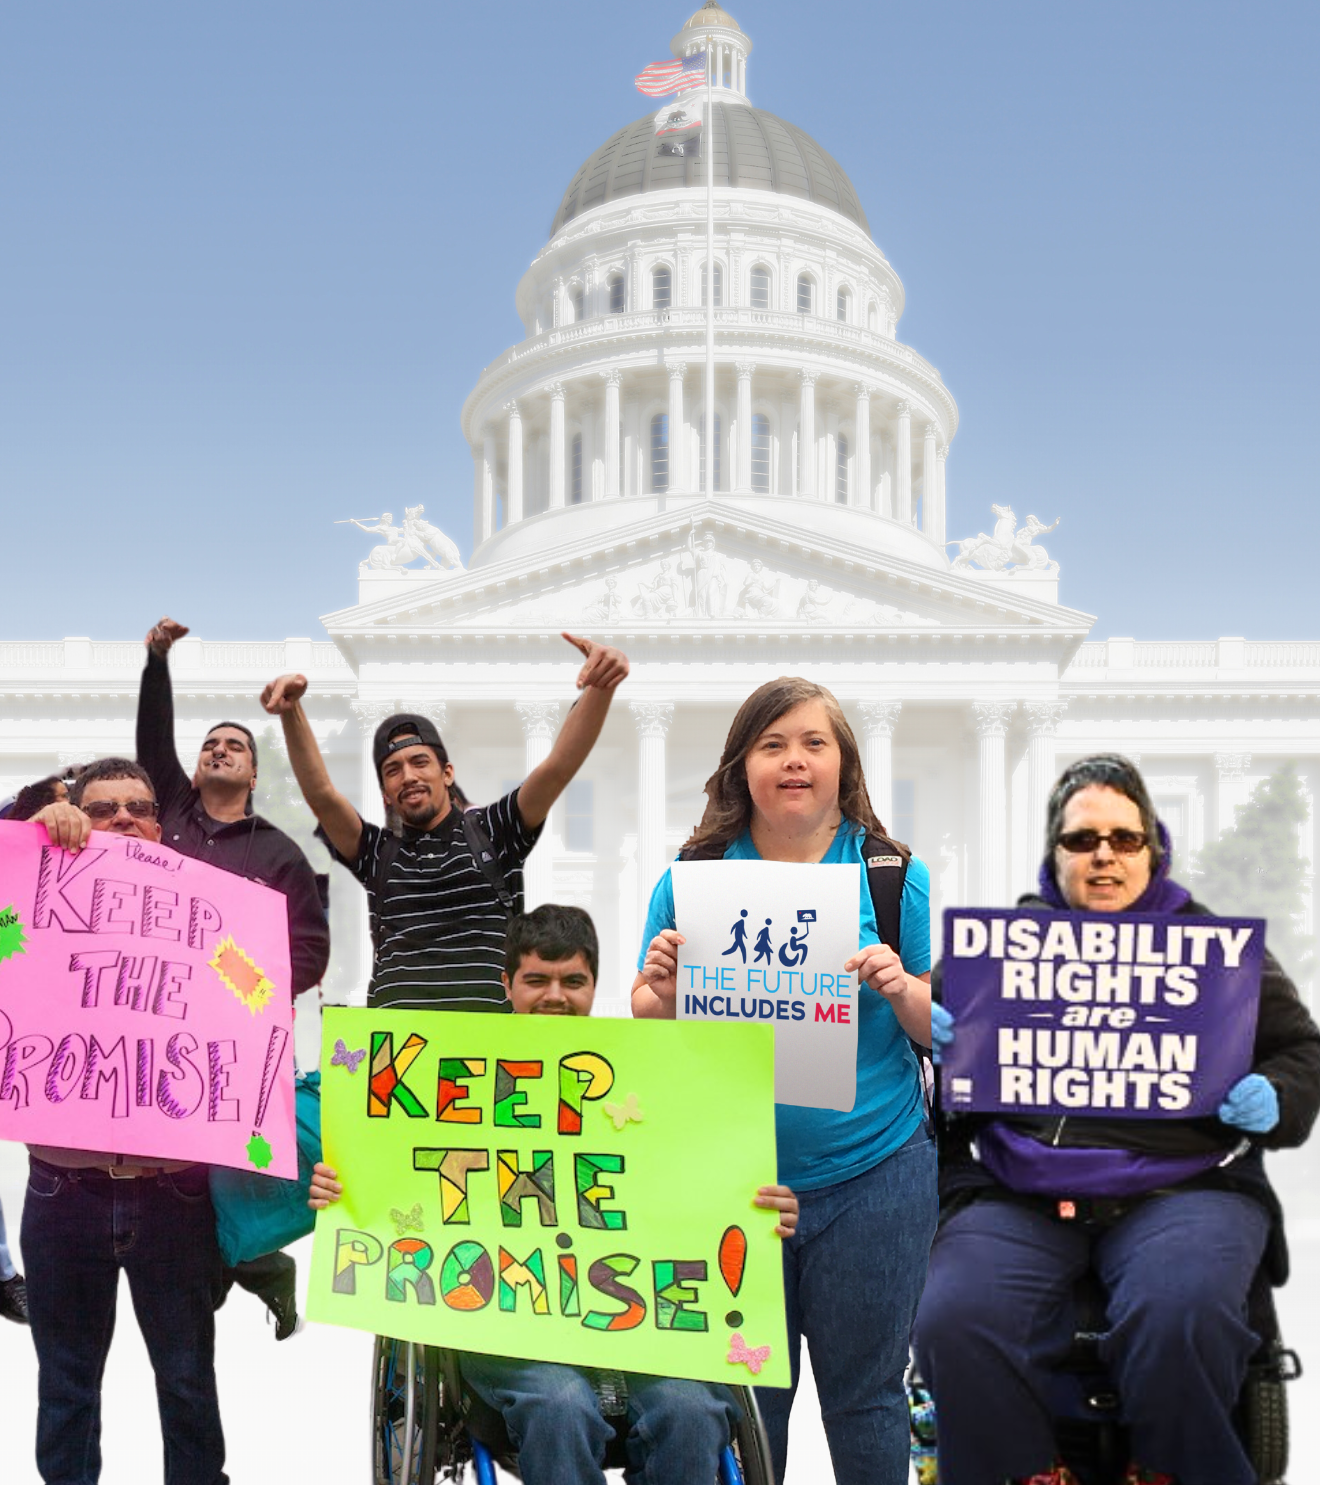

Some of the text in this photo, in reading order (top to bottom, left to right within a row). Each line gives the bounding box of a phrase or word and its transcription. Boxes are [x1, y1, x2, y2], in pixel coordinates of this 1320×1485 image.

[33, 845, 222, 950] KEEP
[952, 918, 1254, 968] DISABILITY
[69, 950, 192, 1020] THE
[683, 964, 852, 998] THE FUTURE
[1001, 961, 1198, 1006] RIGHTS
[684, 994, 851, 1024] INCLUDES ME
[1061, 1006, 1137, 1028] are
[0, 1009, 288, 1137] ROMISE!
[998, 1028, 1198, 1072] HUMAN
[366, 1031, 615, 1136] KEEP
[1000, 1067, 1192, 1111] RIGHTS
[413, 1147, 628, 1231] THE
